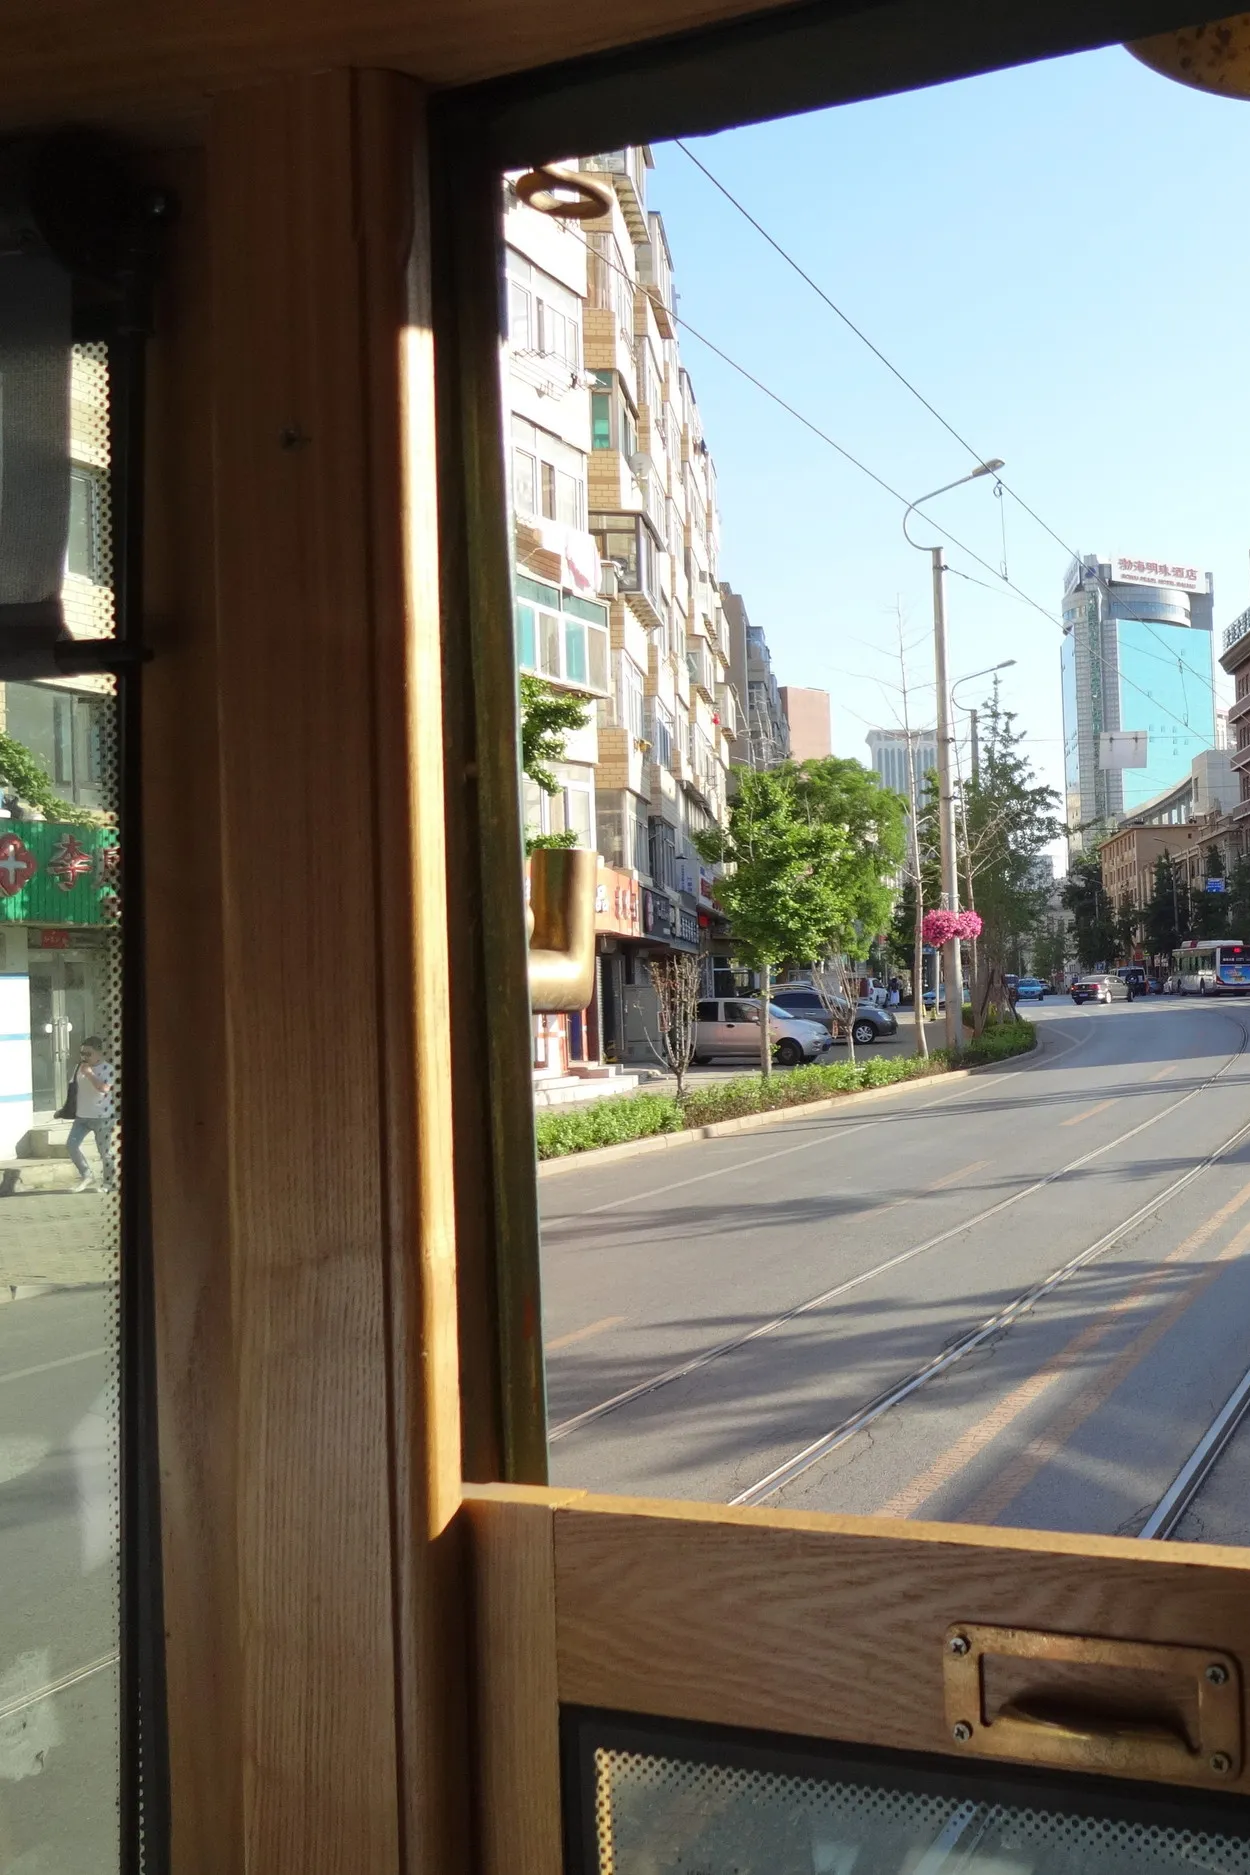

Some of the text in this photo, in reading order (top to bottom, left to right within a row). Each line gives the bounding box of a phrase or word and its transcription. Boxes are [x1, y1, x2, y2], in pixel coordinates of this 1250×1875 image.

[1118, 558, 1198, 581] 渤海明珠酒店
[1139, 576, 1157, 584] PEARL
